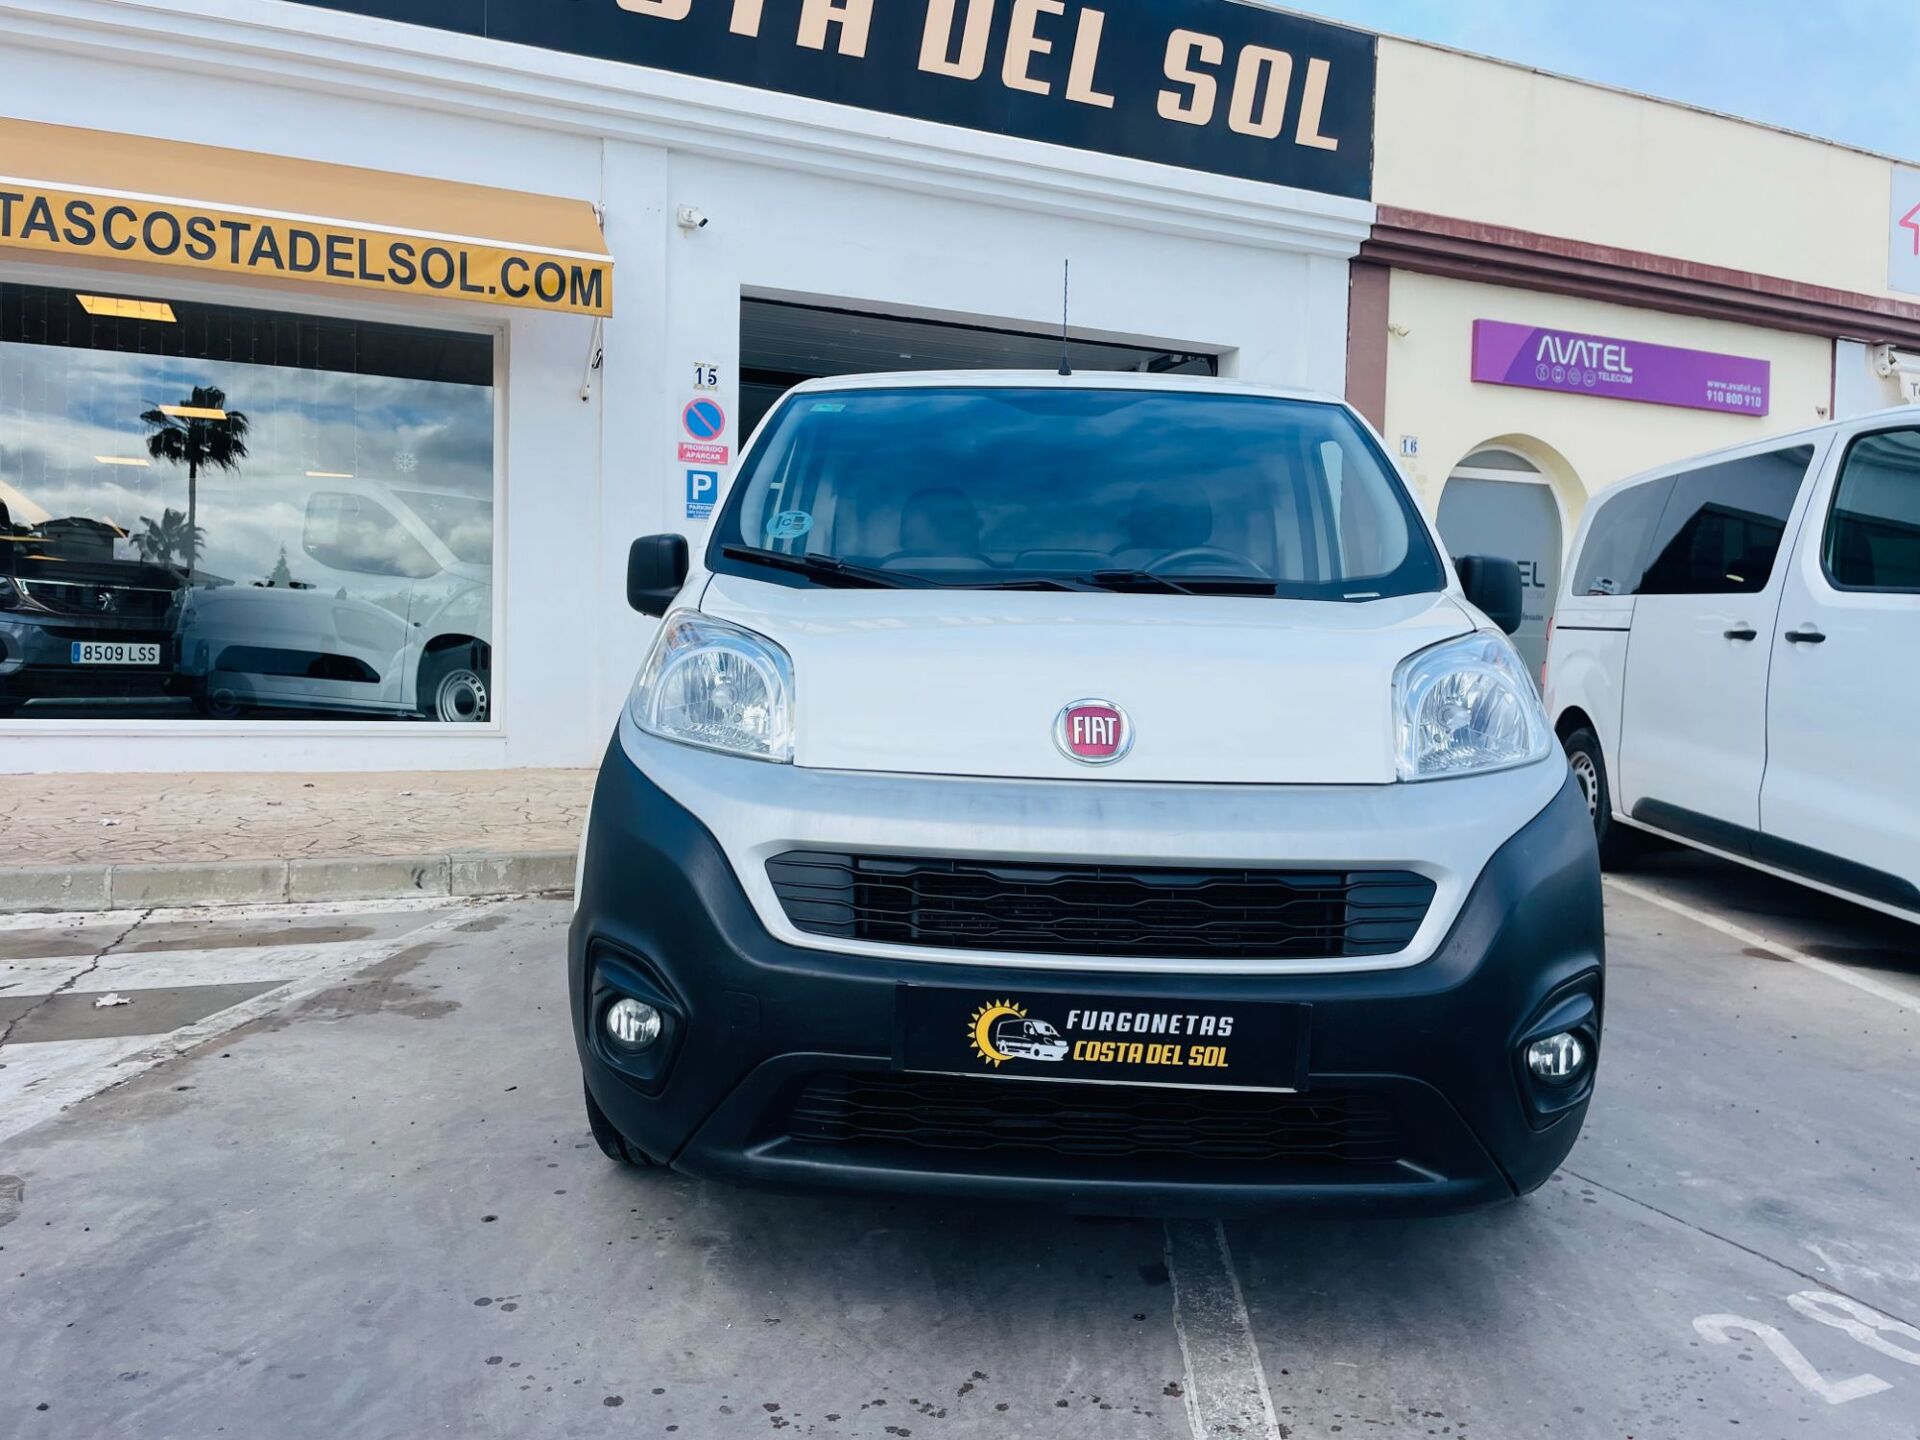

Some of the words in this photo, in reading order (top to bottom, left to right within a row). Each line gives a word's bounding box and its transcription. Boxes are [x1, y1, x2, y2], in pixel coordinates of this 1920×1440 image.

[918, 0, 1114, 108] DEL
[1157, 28, 1338, 151] SOL
[0, 191, 603, 308] TASCOSTADELSOL.COM
[1537, 335, 1633, 373] AVATEL
[695, 367, 717, 386] 15
[1598, 371, 1633, 384] TELECOM
[1707, 390, 1724, 403] 910
[1403, 438, 1417, 453] 16
[692, 473, 712, 500] P
[83, 645, 124, 661] 8509
[128, 646, 156, 662] LSS
[1073, 716, 1117, 745] FIAT
[1066, 1010, 1234, 1037] FURGONETAS
[1073, 1040, 1144, 1064] COSTA
[1145, 1043, 1184, 1066] DEL
[1188, 1046, 1229, 1068] SOL
